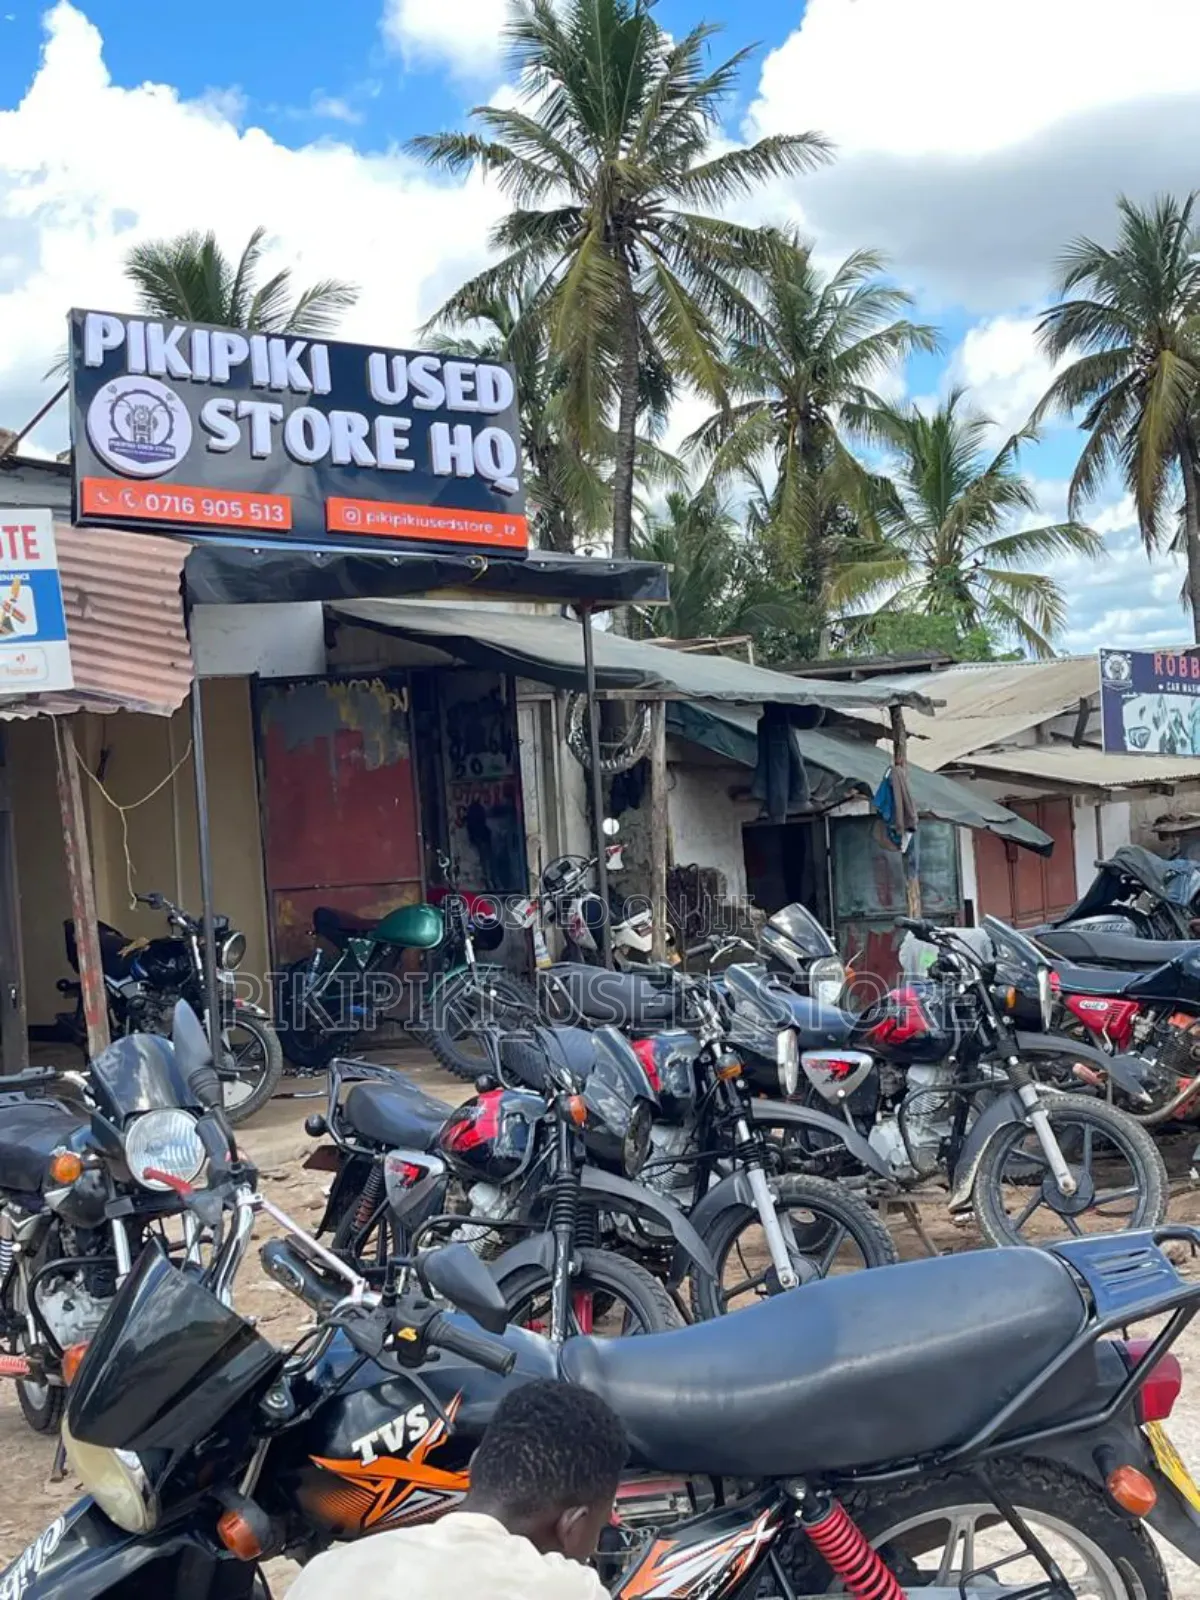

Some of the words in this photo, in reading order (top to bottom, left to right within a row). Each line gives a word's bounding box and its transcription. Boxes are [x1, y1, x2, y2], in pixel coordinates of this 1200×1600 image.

[84, 312, 332, 395] PIKIPIKI
[369, 352, 514, 414] USED
[200, 399, 415, 471] STORE
[430, 422, 519, 494] HQ
[146, 493, 195, 515] 0716
[202, 499, 243, 519] 905
[250, 503, 284, 522] 513
[0, 525, 41, 561] TE
[351, 1403, 430, 1467] TVS
